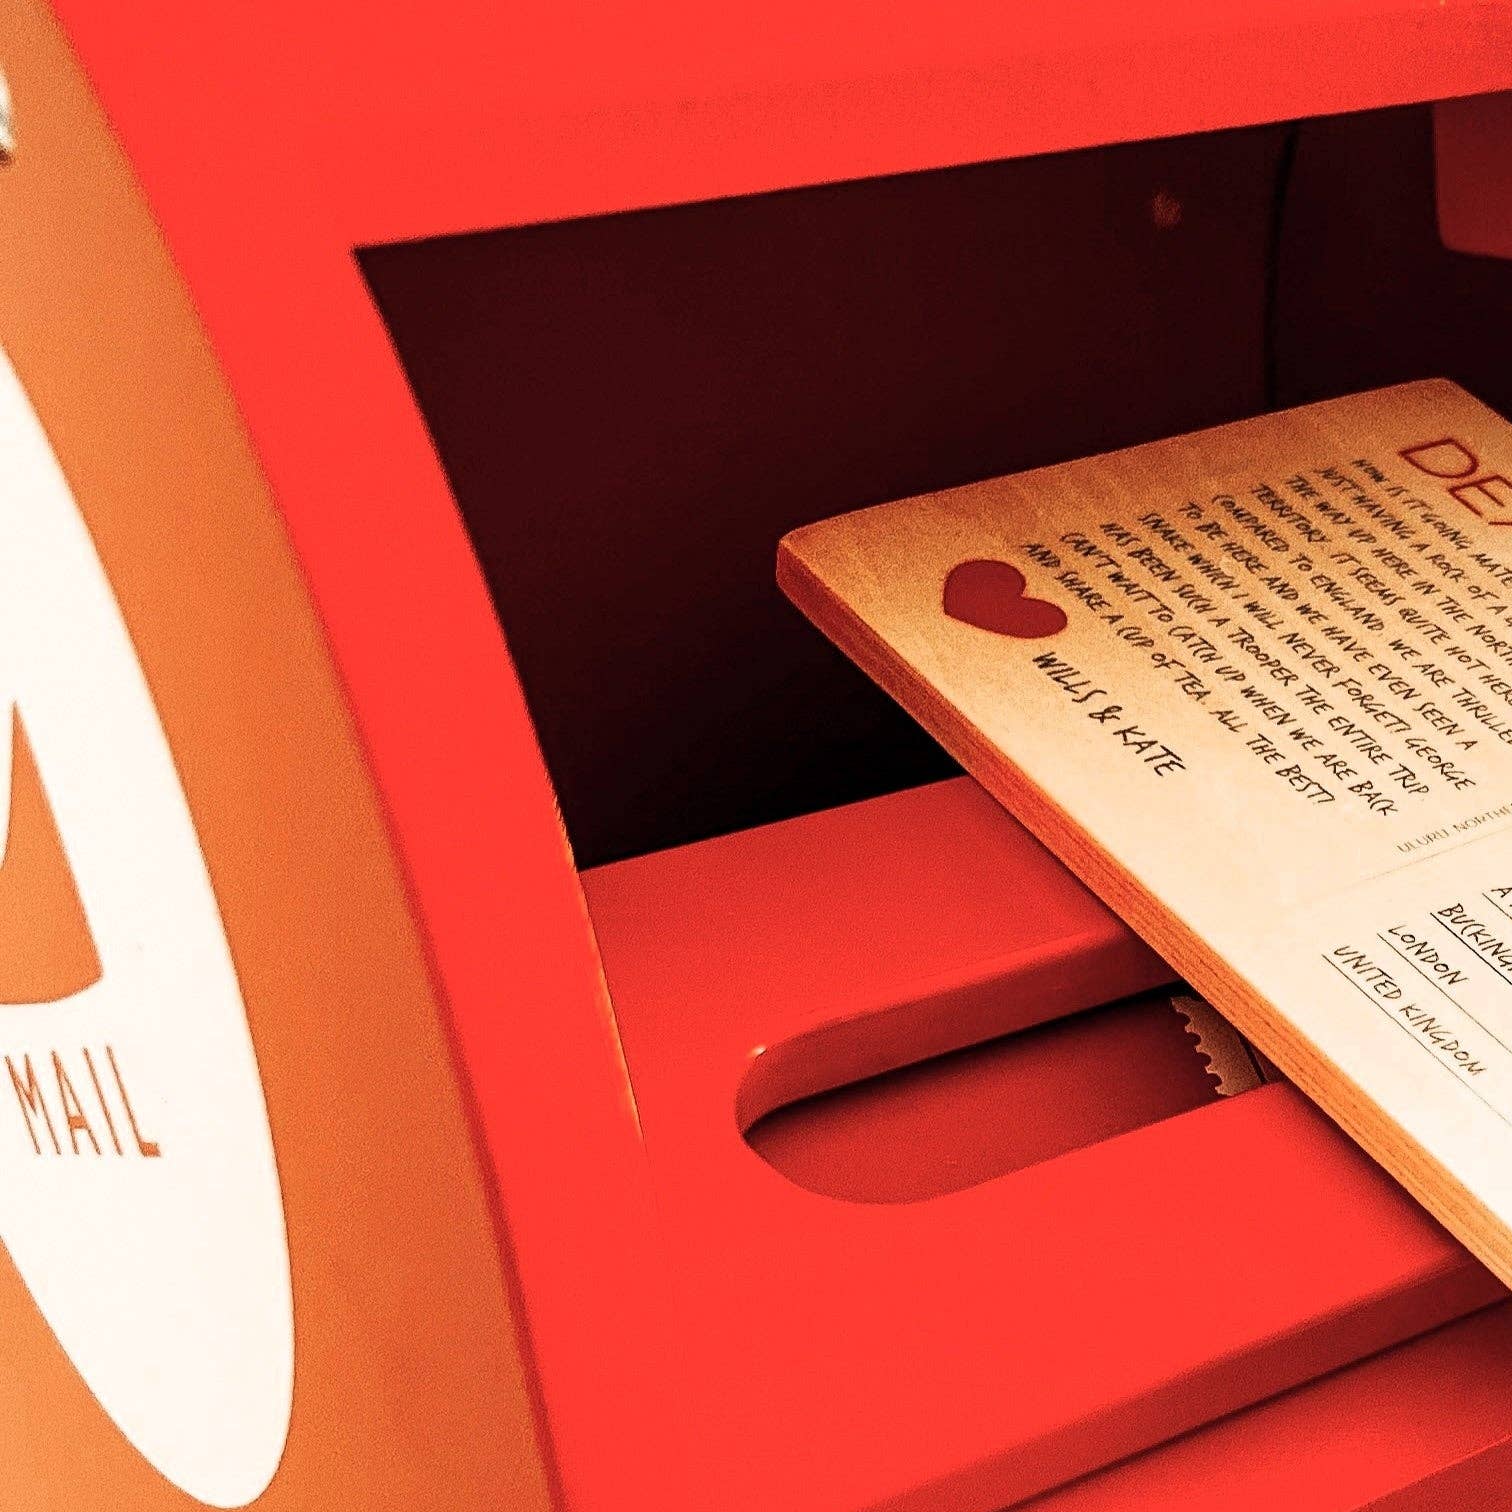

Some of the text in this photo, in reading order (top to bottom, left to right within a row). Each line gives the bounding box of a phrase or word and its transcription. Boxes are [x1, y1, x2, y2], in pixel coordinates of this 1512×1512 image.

[1283, 473, 1324, 502] THE
[1312, 500, 1358, 526] WAY
[1346, 527, 1378, 544] UP
[1370, 547, 1420, 581] HERE
[1410, 580, 1442, 596] IN
[1435, 594, 1475, 624] THE
[1350, 494, 1418, 541] HAVING
[1408, 542, 1432, 554] A
[1424, 552, 1470, 584] ROCK
[1466, 584, 1501, 601] OF
[1485, 605, 1509, 616] A
[1383, 485, 1411, 499] IS
[1400, 497, 1435, 512] IT
[1419, 511, 1475, 552] GOING
[1018, 542, 1062, 570] AND
[1052, 569, 1113, 613] SHARE
[1099, 613, 1125, 626] A
[1115, 625, 1156, 649] CUP
[1150, 651, 1187, 670] OF
[1208, 709, 1249, 734] ALL
[1245, 732, 1287, 765] THE
[1098, 522, 1143, 548] HAS
[1126, 546, 1183, 583] BEEN
[1170, 582, 1219, 615] SUCH
[1206, 617, 1232, 629] A
[1226, 625, 1300, 688] TROOPER
[1294, 683, 1335, 716] THE
[1327, 715, 1394, 766] ENTIRE
[1136, 511, 1197, 555] SNAKE
[1186, 552, 1241, 592] WHICH
[1242, 600, 1285, 631] WILL
[1276, 631, 1341, 680] NEVER
[1404, 737, 1477, 791] GEORGE
[1176, 500, 1479, 752] TO BE HERE AND WE HAVE EVEN SEEN A
[1210, 493, 1291, 553] COMPARED
[1287, 551, 1315, 573] TO
[1387, 638, 1423, 662] WE
[1411, 662, 1456, 689] ARE
[1328, 550, 1363, 566] IT
[1347, 566, 1407, 607] SEEMS
[1397, 607, 1452, 646] QUITE
[1443, 645, 1492, 671] HOT
[1031, 650, 1187, 778] WILLS & KATE
[1106, 568, 1163, 604] WAIT
[1147, 601, 1176, 624] TO
[1167, 625, 1224, 664] CATCH
[1214, 664, 1247, 683] UP
[1239, 684, 1298, 727] WHEN
[1288, 727, 1325, 752] WE
[1313, 753, 1359, 782] ARE
[1346, 779, 1399, 817] BACK
[1332, 945, 1487, 1077] UNITED KINGDOM
[1387, 925, 1469, 986] LONDON
[4, 1045, 161, 1158] MAIL
